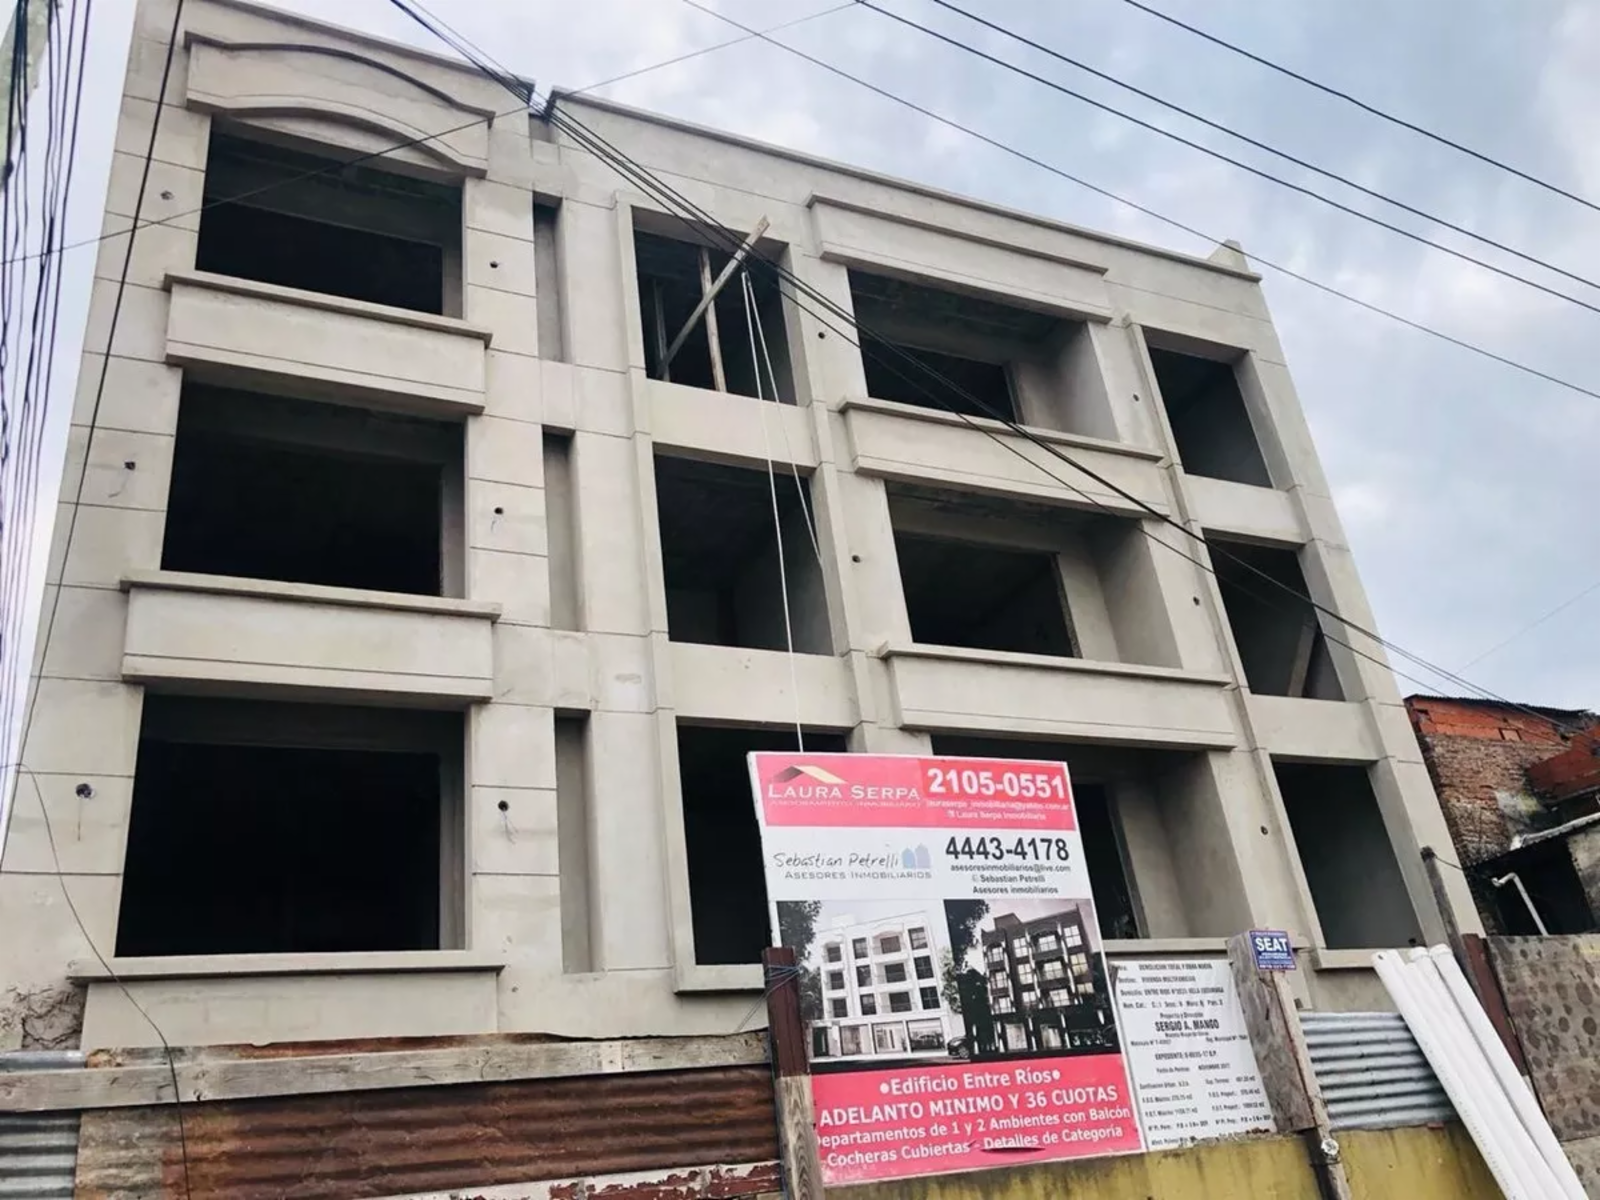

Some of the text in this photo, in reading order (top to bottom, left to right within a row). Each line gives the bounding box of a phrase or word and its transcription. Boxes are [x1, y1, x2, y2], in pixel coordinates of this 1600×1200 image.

[927, 768, 1065, 799] 2105-0551
[768, 784, 920, 800] LAURA SERPA
[945, 836, 1069, 861] 4443-4178
[773, 852, 899, 869] Sebastian Petrelli
[950, 863, 1071, 873] asesoresinmobiliarios@live.com
[785, 871, 932, 880] ASESORES INMOBILIARIOS
[980, 874, 1018, 883] Sebastian
[972, 886, 1058, 894] Asesores inmobiliarios
[1255, 936, 1288, 951] SEAT
[1155, 1020, 1182, 1032] SERGIO
[1192, 1018, 1220, 1030] MANGO
[963, 1073, 1011, 1089] Entre
[820, 1101, 924, 1127] ADELANTO
[929, 1094, 1003, 1117] MINIMO
[1008, 1093, 1019, 1109] Y
[1025, 1091, 1047, 1108] 36
[1051, 1085, 1118, 1106] CUOTAS
[930, 1123, 948, 1136] de
[952, 1122, 960, 1135] 1
[964, 1122, 973, 1137] y
[977, 1119, 986, 1132] 2
[989, 1113, 1060, 1131] Ambientes
[1063, 1111, 1086, 1123] con
[1088, 1106, 1131, 1121] Balcón
[827, 1149, 898, 1167] Cocheras
[902, 1142, 970, 1160] Cubiertas
[983, 1133, 1039, 1150] Detalles
[1042, 1131, 1058, 1145] de
[1061, 1125, 1123, 1143] Categoría
